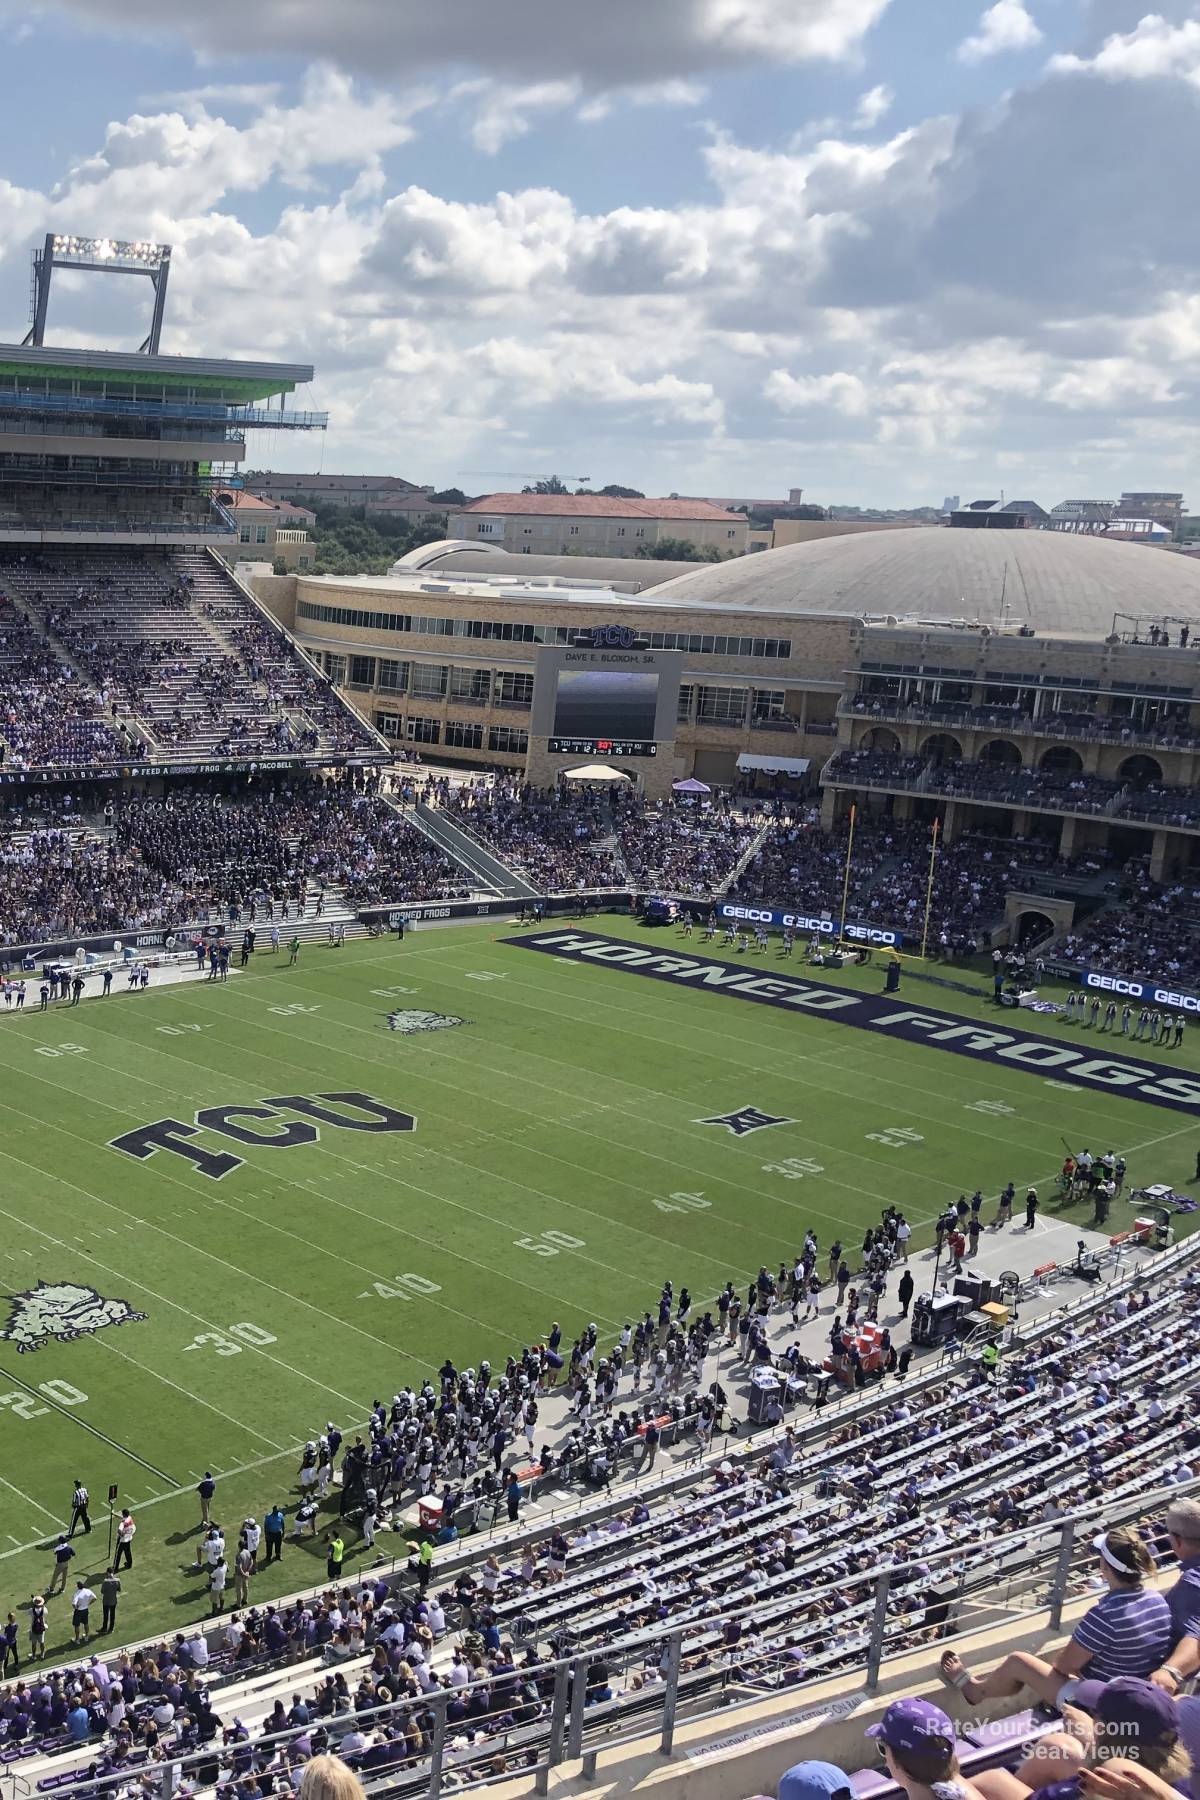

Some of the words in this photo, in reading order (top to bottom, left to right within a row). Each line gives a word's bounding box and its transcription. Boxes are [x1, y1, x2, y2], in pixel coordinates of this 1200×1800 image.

[592, 625, 635, 647] TCU
[566, 653, 587, 662] DAVE
[643, 656, 656, 664] SR.
[141, 768, 160, 776] FEED
[389, 910, 422, 922] HORNED
[424, 908, 450, 918] FROGS
[722, 904, 773, 924] GEICO
[782, 914, 833, 933] GEICO
[136, 934, 164, 946] HORN
[844, 924, 895, 944] GEICO
[531, 934, 862, 1010] HORNED
[1087, 974, 1143, 997] GEICO
[267, 1004, 312, 1016] 30
[156, 1022, 203, 1036] 40
[34, 1043, 90, 1058] 50
[106, 1091, 418, 1182] TCU
[865, 1128, 924, 1148] 20
[762, 1158, 824, 1180] 30
[651, 1193, 712, 1214] 40
[513, 1230, 586, 1256] 50
[374, 1272, 443, 1301] 40
[198, 1322, 278, 1356] 30
[0, 1379, 89, 1420] 20
[94, 1704, 106, 1718] 14
[832, 1704, 848, 1714] ON
